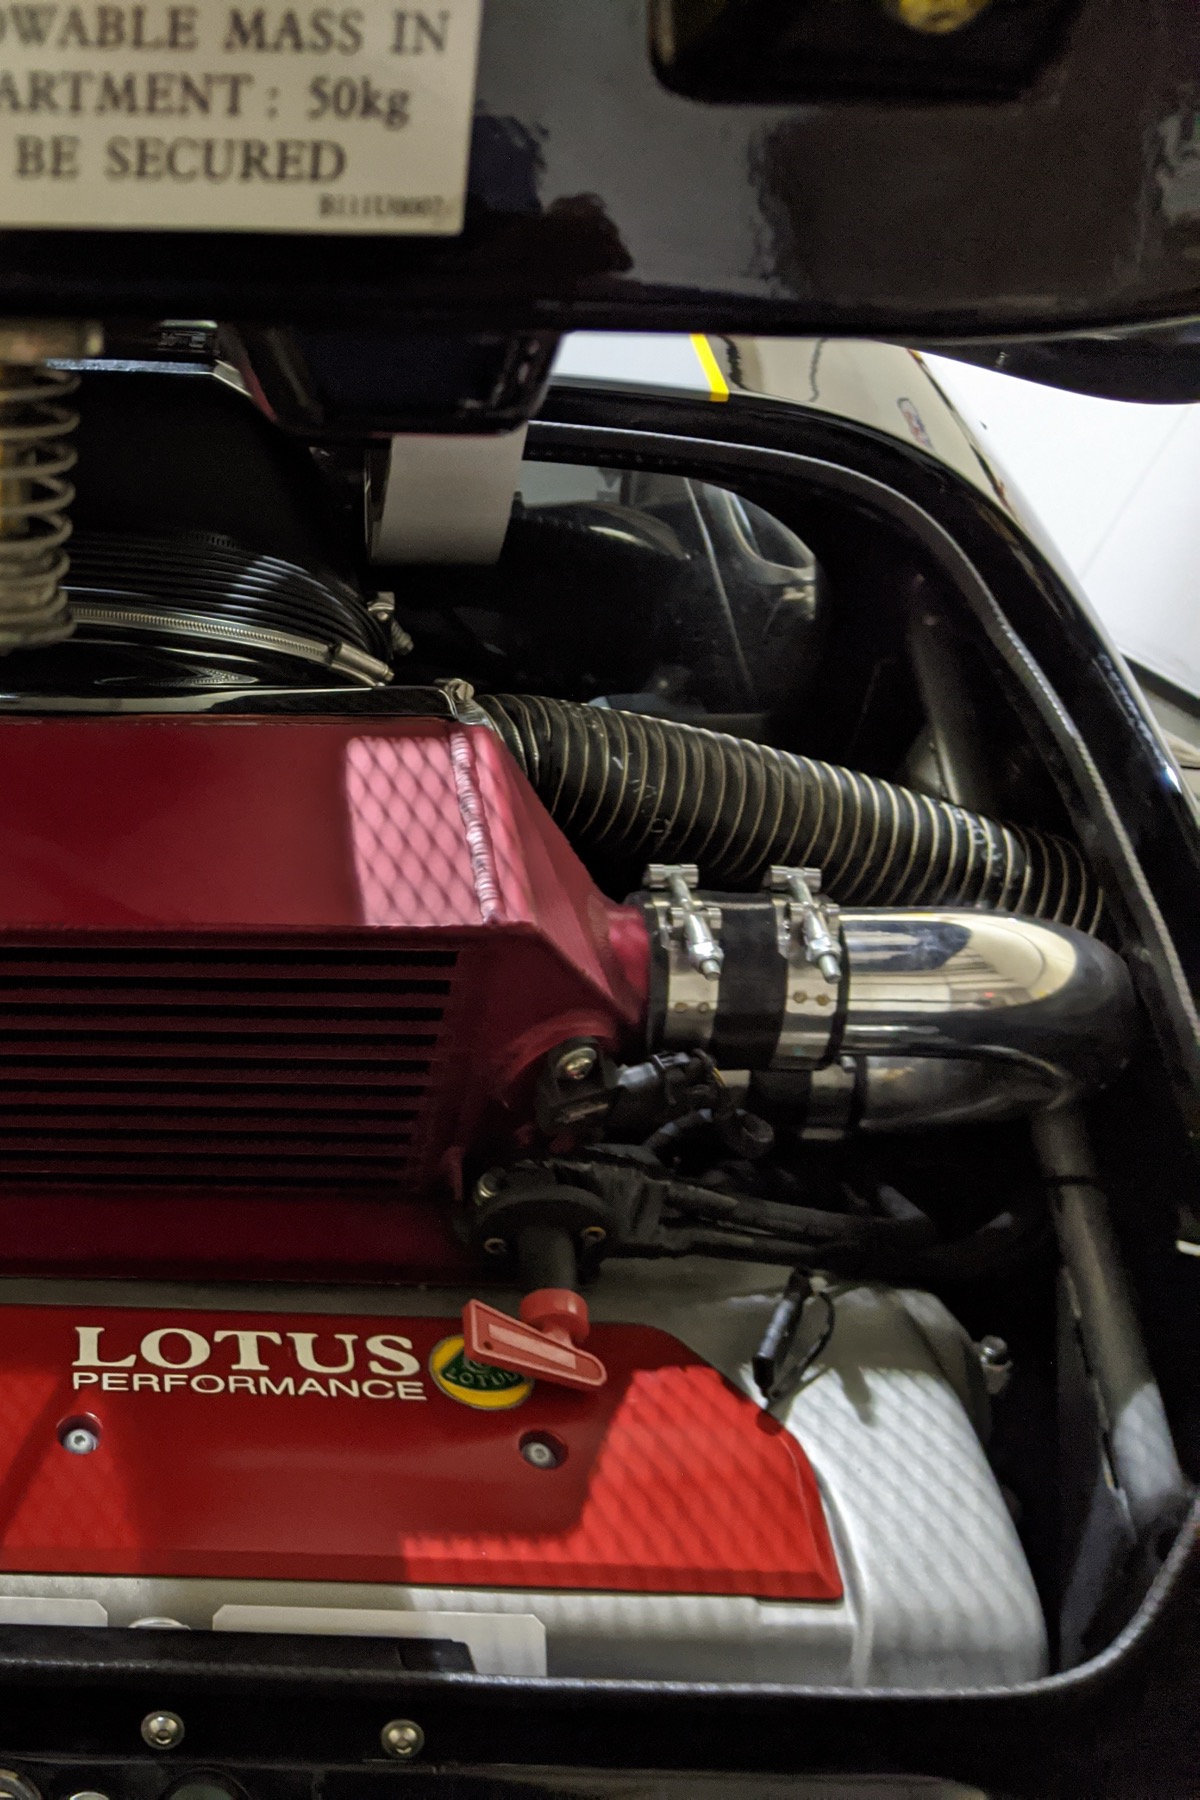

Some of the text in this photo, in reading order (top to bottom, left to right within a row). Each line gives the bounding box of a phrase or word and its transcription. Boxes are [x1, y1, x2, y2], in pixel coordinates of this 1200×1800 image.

[223, 6, 366, 56] MASS
[389, 8, 452, 55] IN
[305, 74, 412, 130] 50kg
[14, 134, 81, 181] BE
[103, 136, 348, 184] SECURED
[71, 1326, 421, 1377] LOTUS
[72, 1371, 428, 1401] PERFORMANCE
